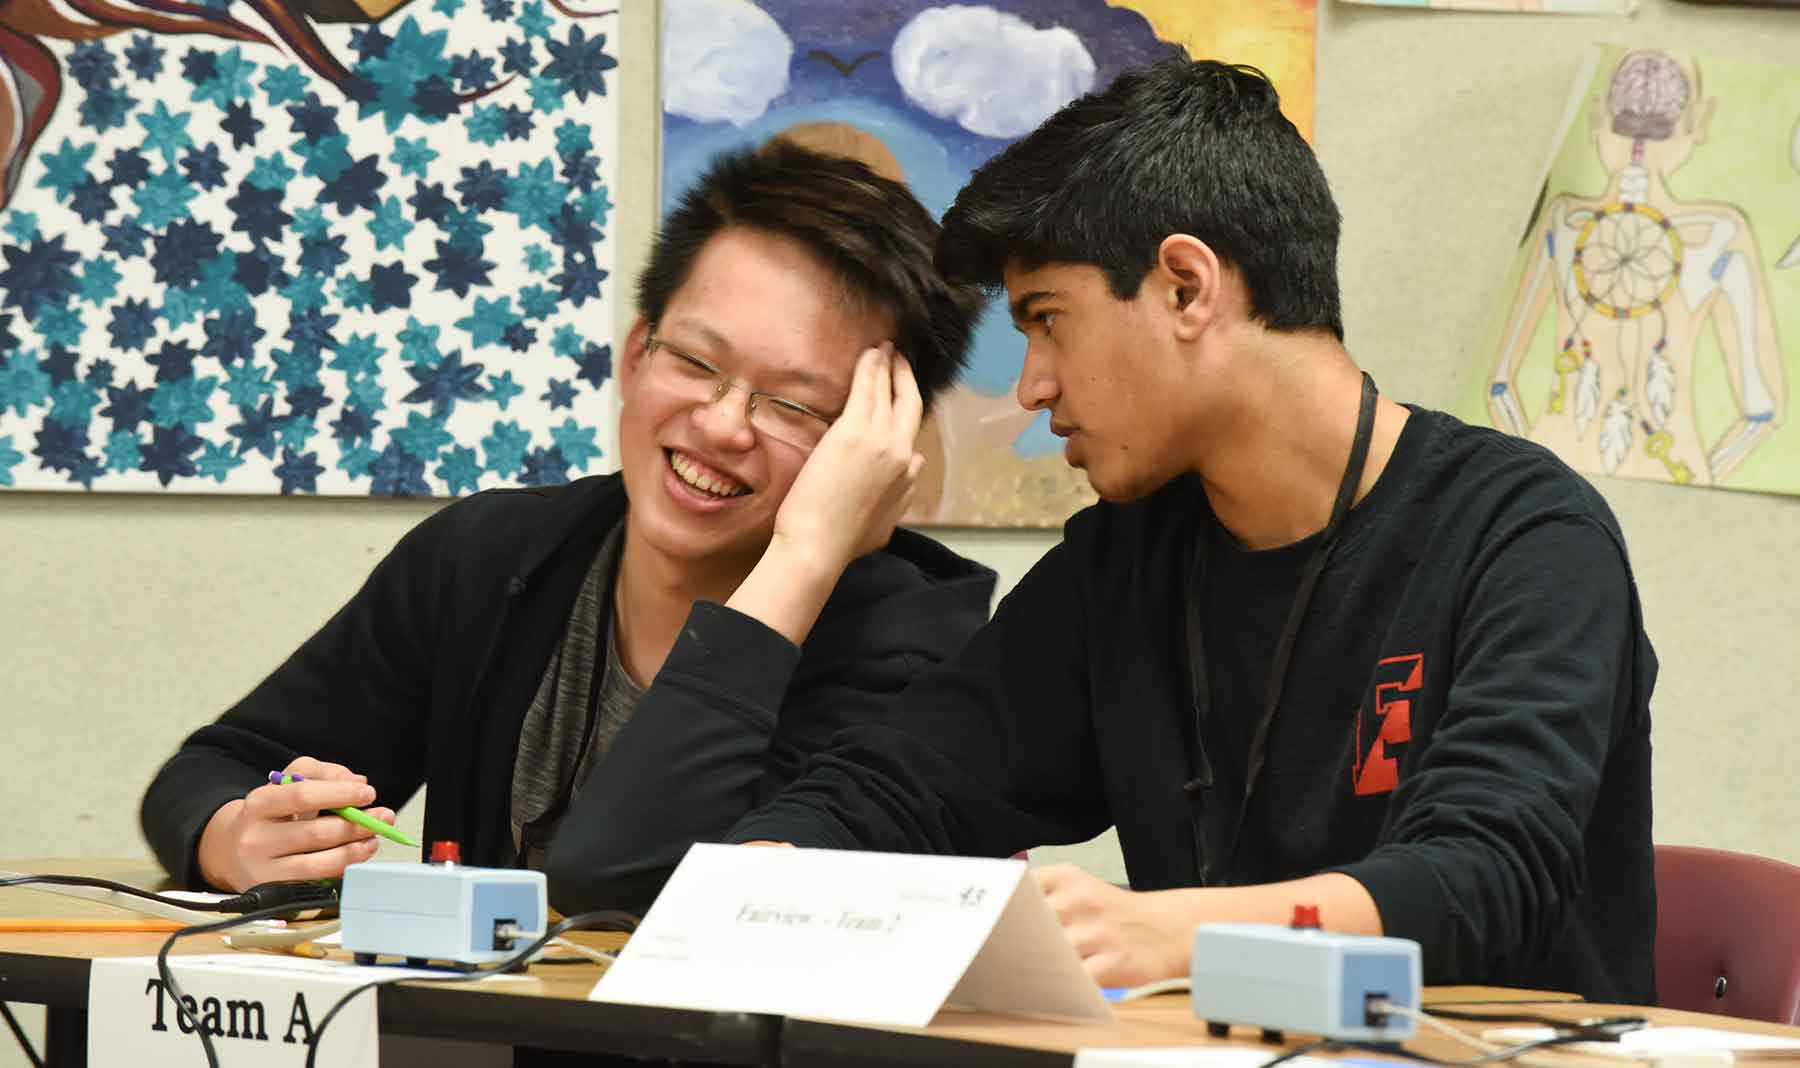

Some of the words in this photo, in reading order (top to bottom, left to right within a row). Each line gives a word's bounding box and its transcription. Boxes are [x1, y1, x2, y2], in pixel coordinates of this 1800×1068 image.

[1353, 653, 1424, 796] F
[735, 902, 813, 927] Fairview
[836, 909, 883, 933] Team
[145, 978, 269, 1041] Team
[283, 992, 319, 1045] A
